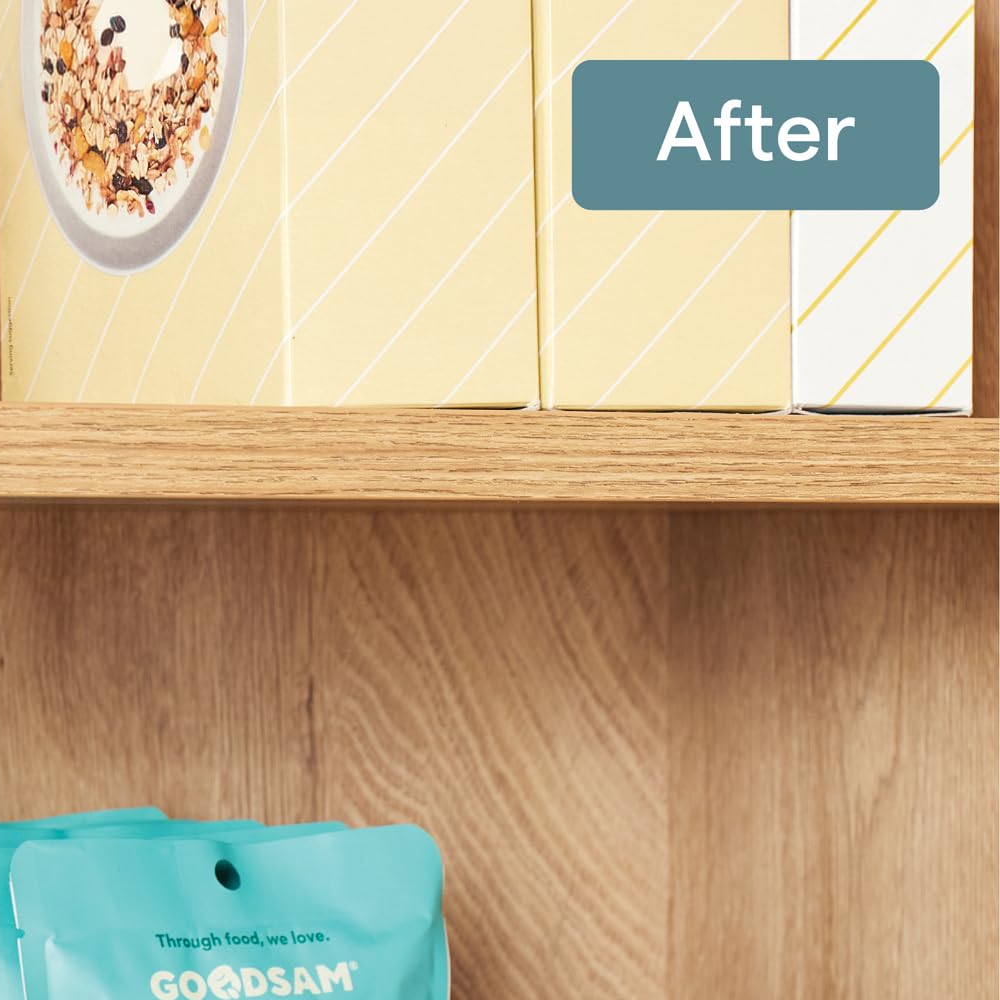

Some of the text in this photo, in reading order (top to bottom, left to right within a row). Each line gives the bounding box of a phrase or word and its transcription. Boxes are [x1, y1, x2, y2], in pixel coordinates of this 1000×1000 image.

[156, 930, 330, 951] Through food, we love.
